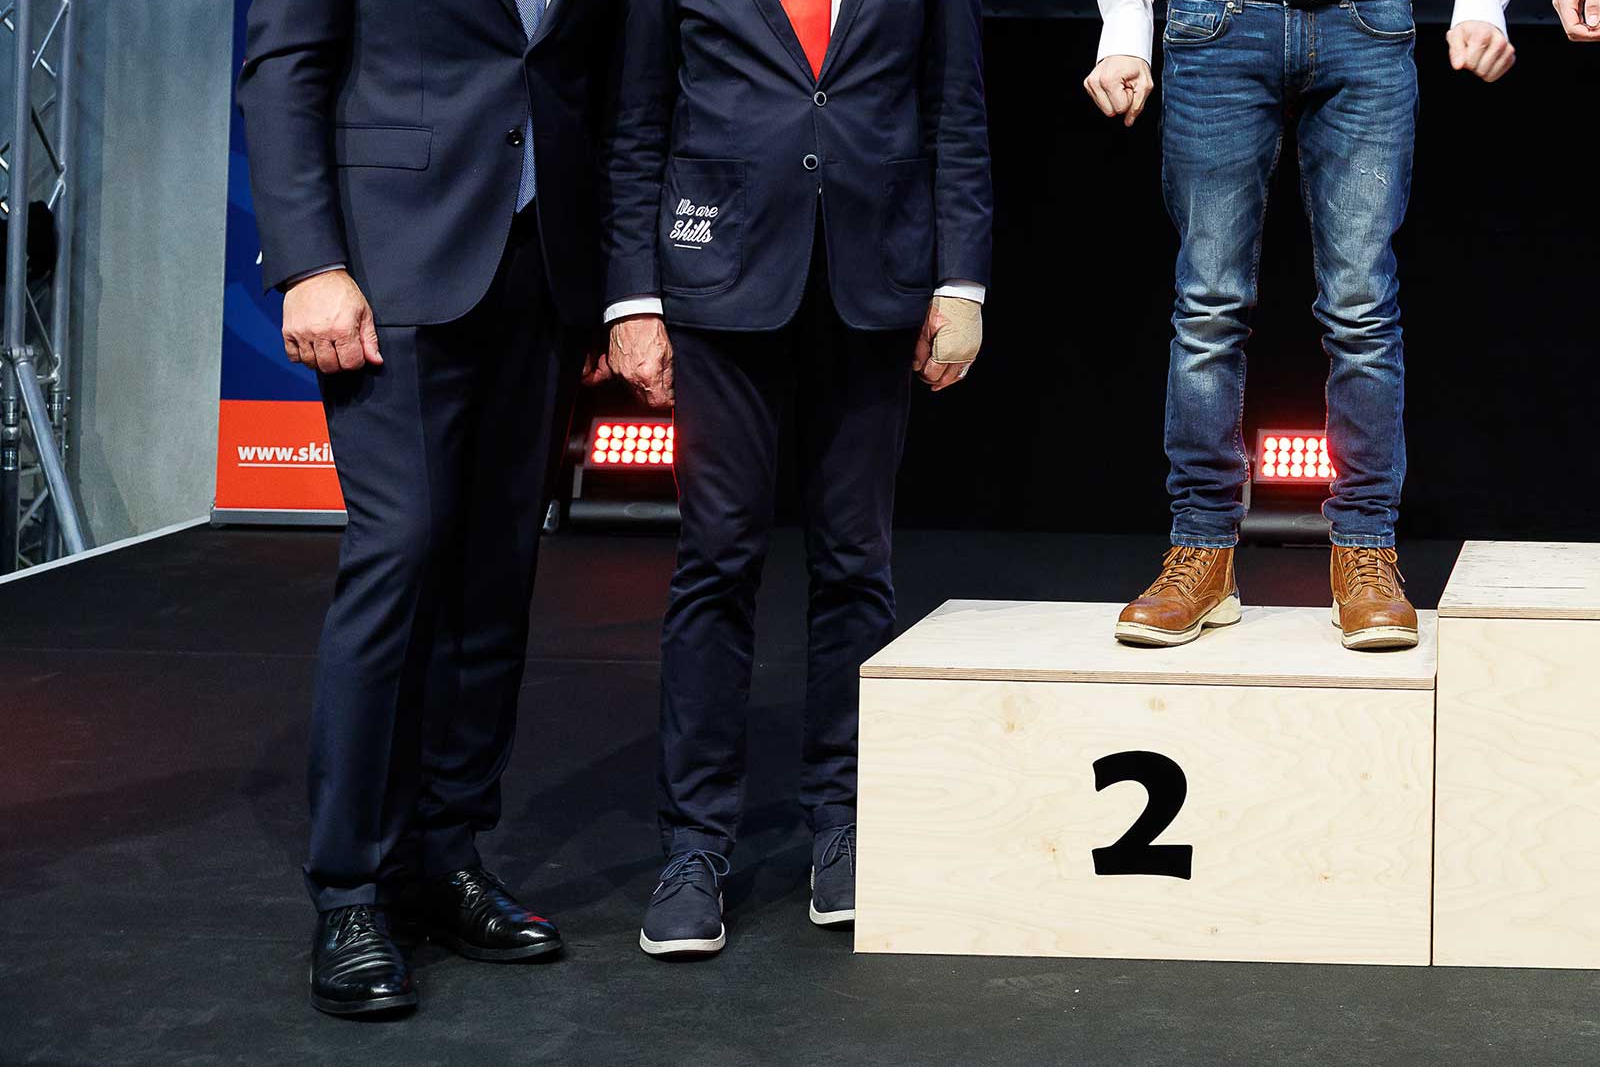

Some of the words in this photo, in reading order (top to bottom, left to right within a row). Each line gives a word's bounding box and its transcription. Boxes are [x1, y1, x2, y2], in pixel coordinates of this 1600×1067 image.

[676, 198, 695, 215] We
[695, 205, 719, 218] are
[669, 218, 714, 243] Skills
[1092, 751, 1192, 880] 2
